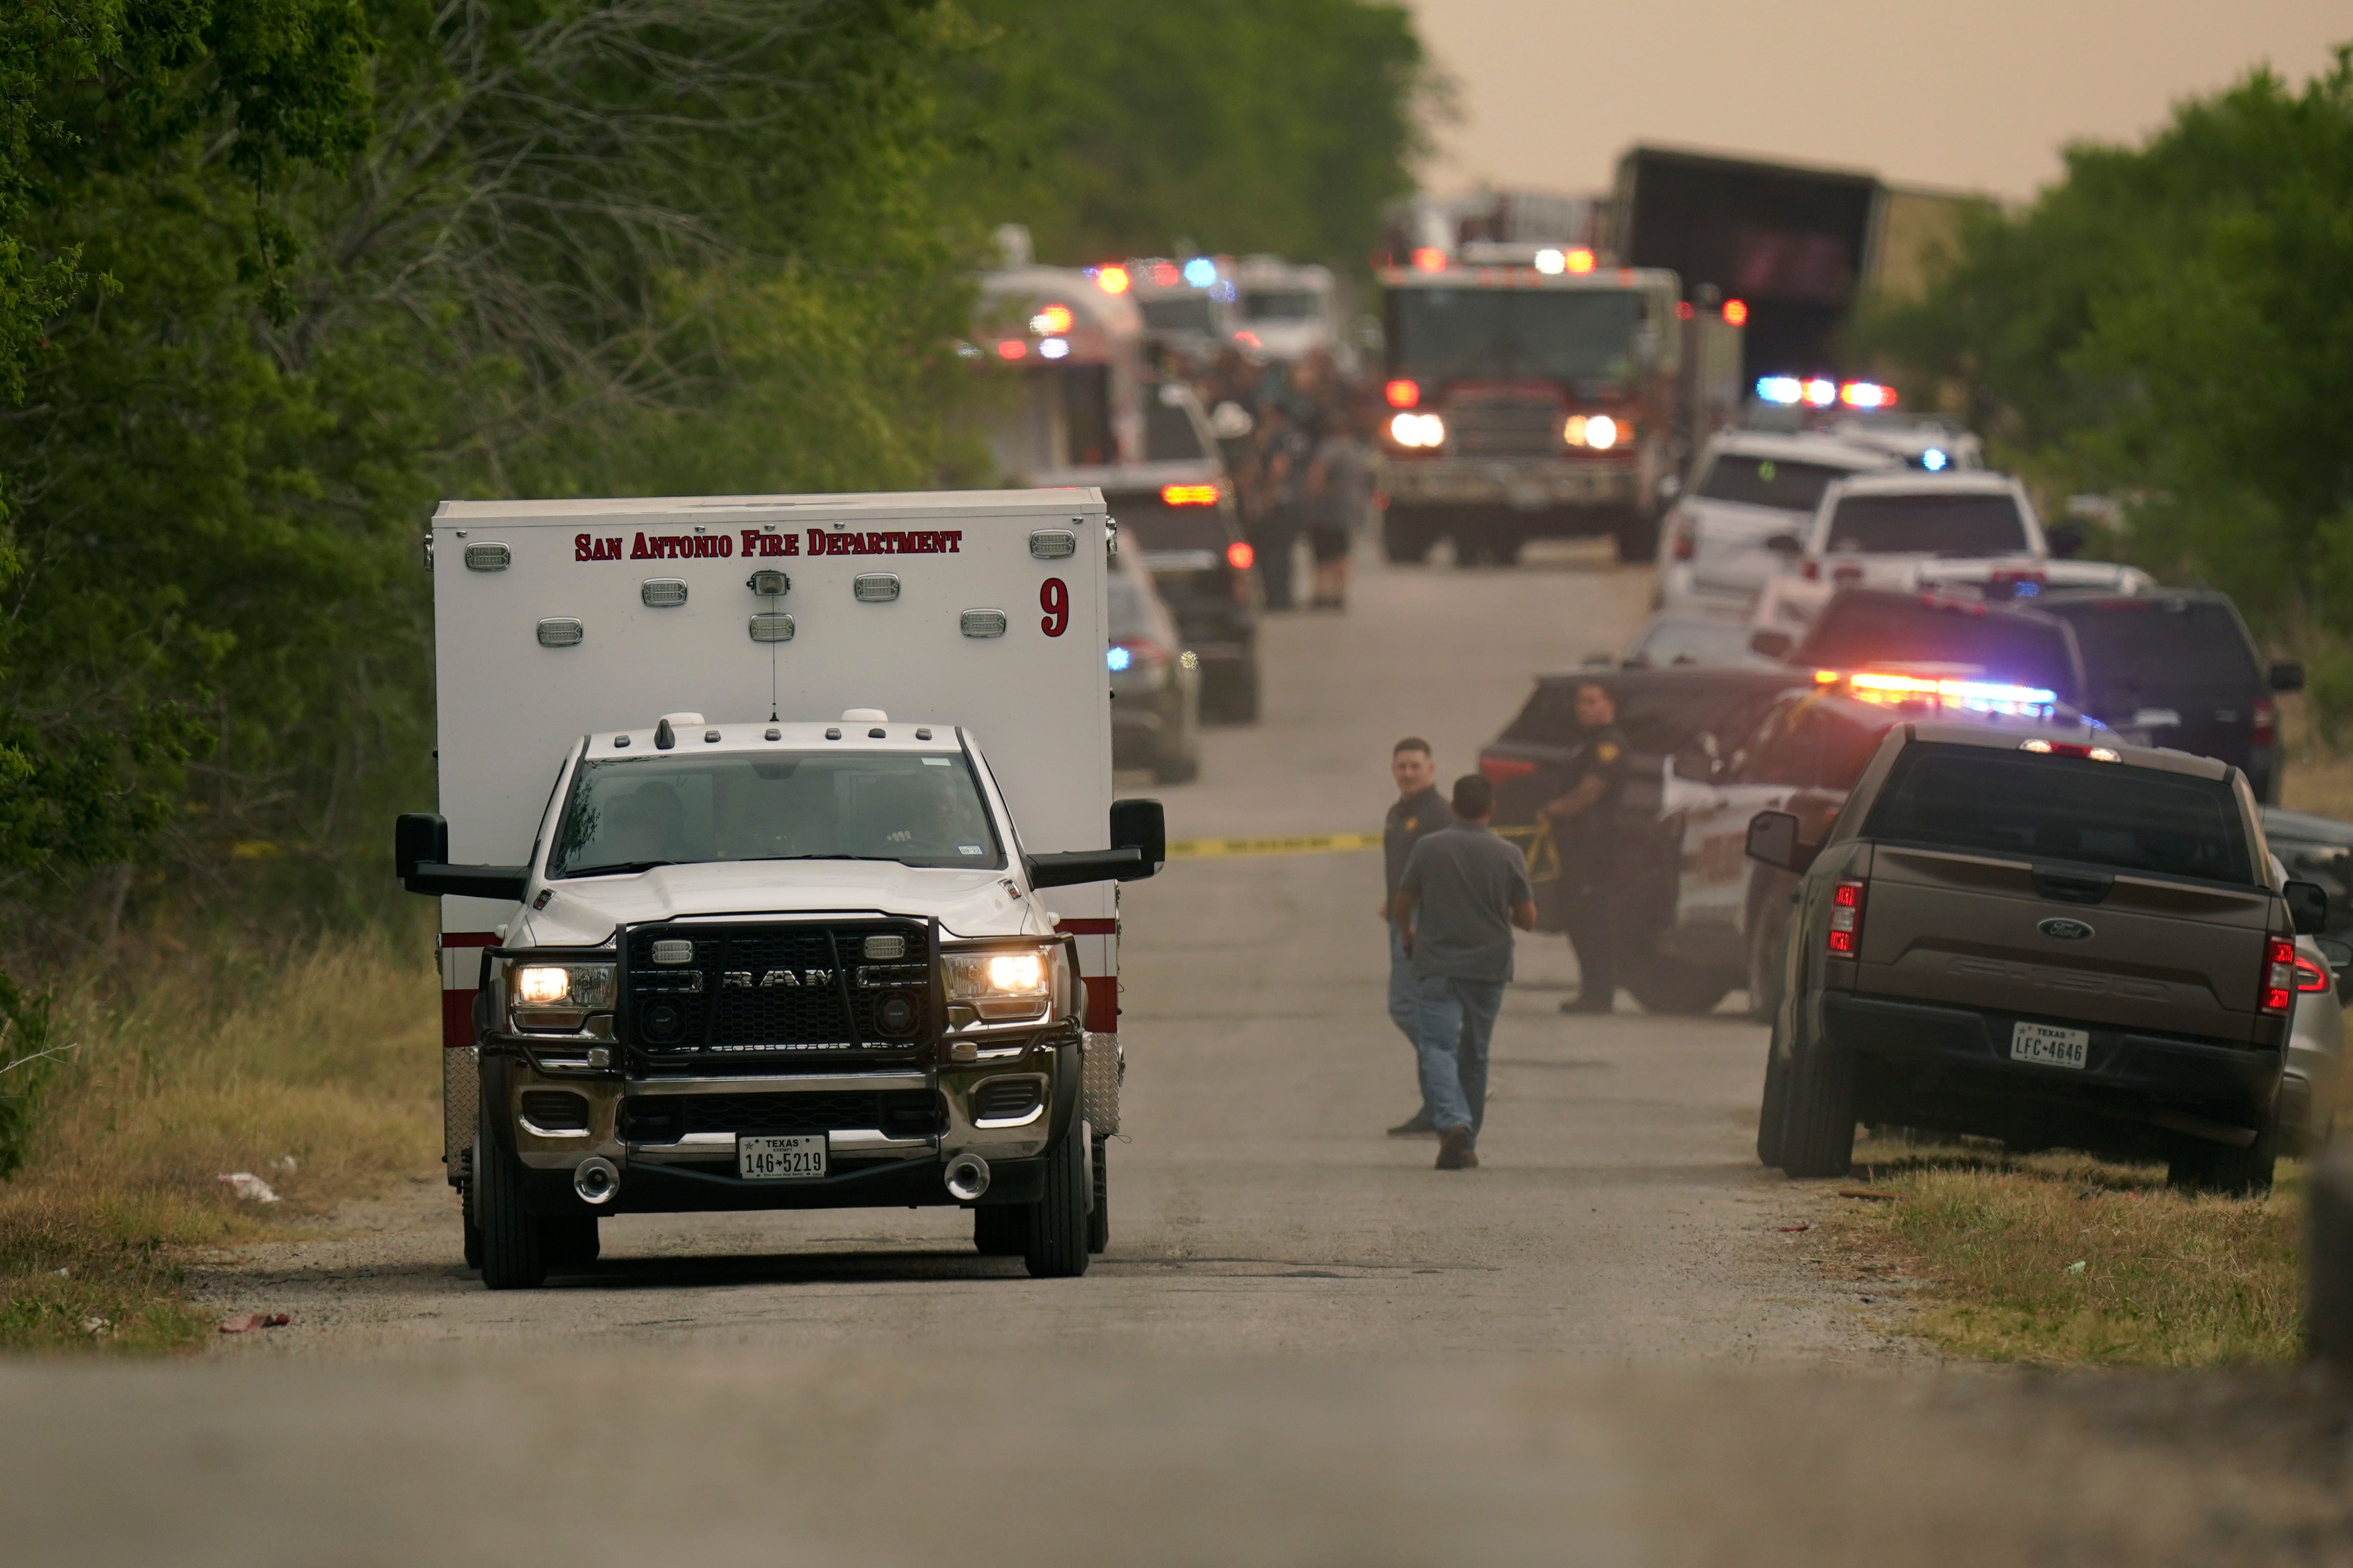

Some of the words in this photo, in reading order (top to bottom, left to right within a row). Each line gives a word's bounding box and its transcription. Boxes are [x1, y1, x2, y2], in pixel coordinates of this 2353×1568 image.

[575, 534, 622, 561] SAN
[630, 532, 732, 559] ANTONIO
[741, 530, 799, 557] FIRE
[807, 529, 962, 556] DEPARTMENT
[1040, 577, 1069, 637] 9
[722, 969, 847, 989] RAM
[2037, 1028, 2066, 1039] TEXAS
[765, 1139, 799, 1148] TEXAS
